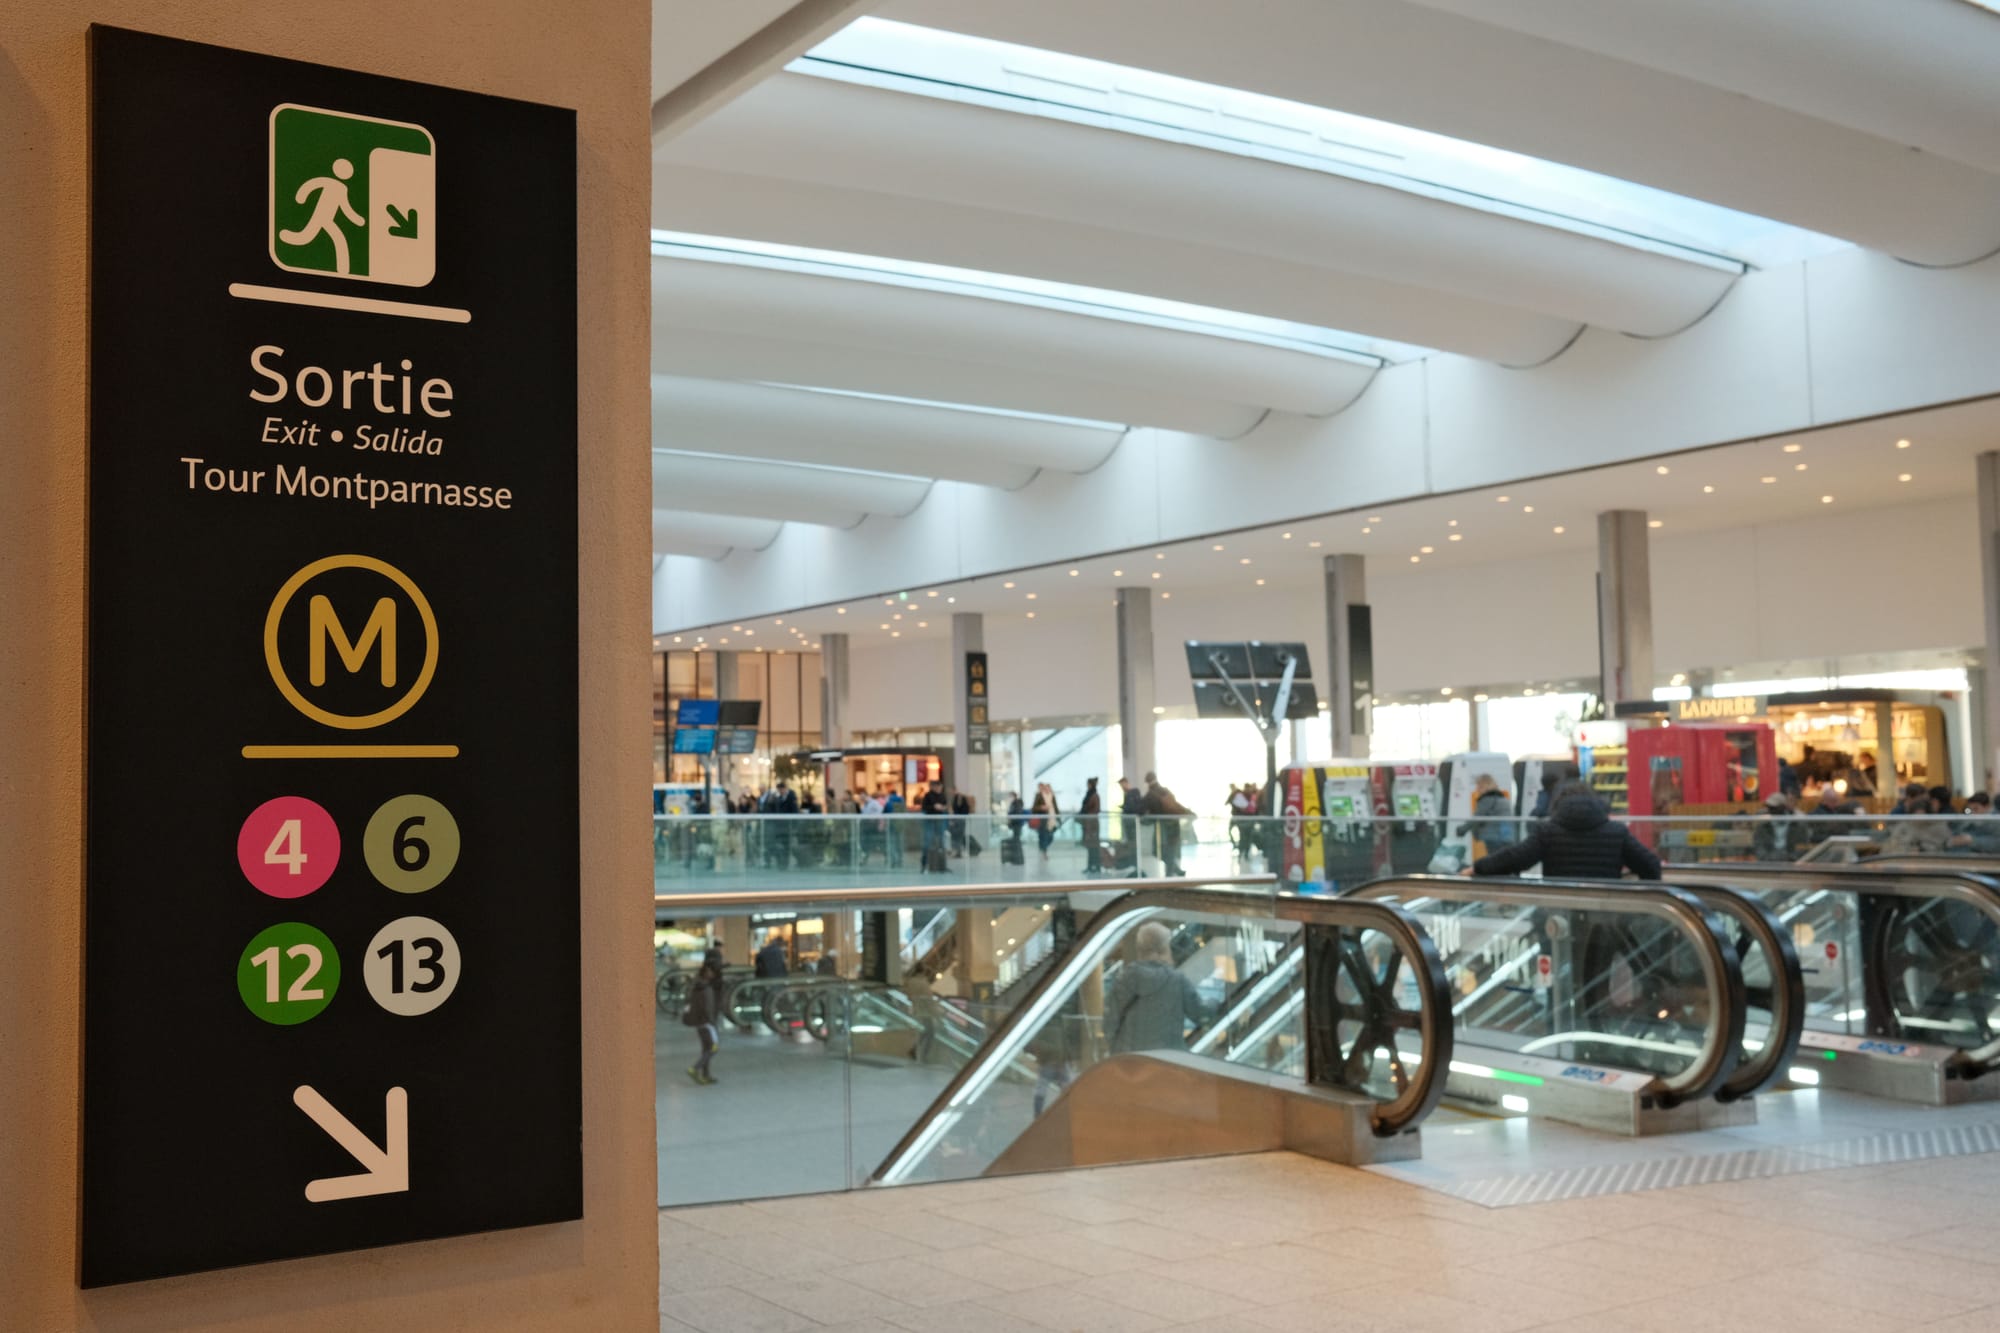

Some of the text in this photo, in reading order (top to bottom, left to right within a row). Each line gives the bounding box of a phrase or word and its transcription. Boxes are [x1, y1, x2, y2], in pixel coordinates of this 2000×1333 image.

[249, 344, 454, 418] Sortie
[261, 417, 443, 456] Exit Salida
[180, 457, 513, 510] Tour Montparnasse
[309, 594, 397, 688] M
[264, 819, 308, 875] 4
[392, 815, 430, 872] 6
[250, 943, 324, 1003] 12
[377, 936, 446, 994] 13
